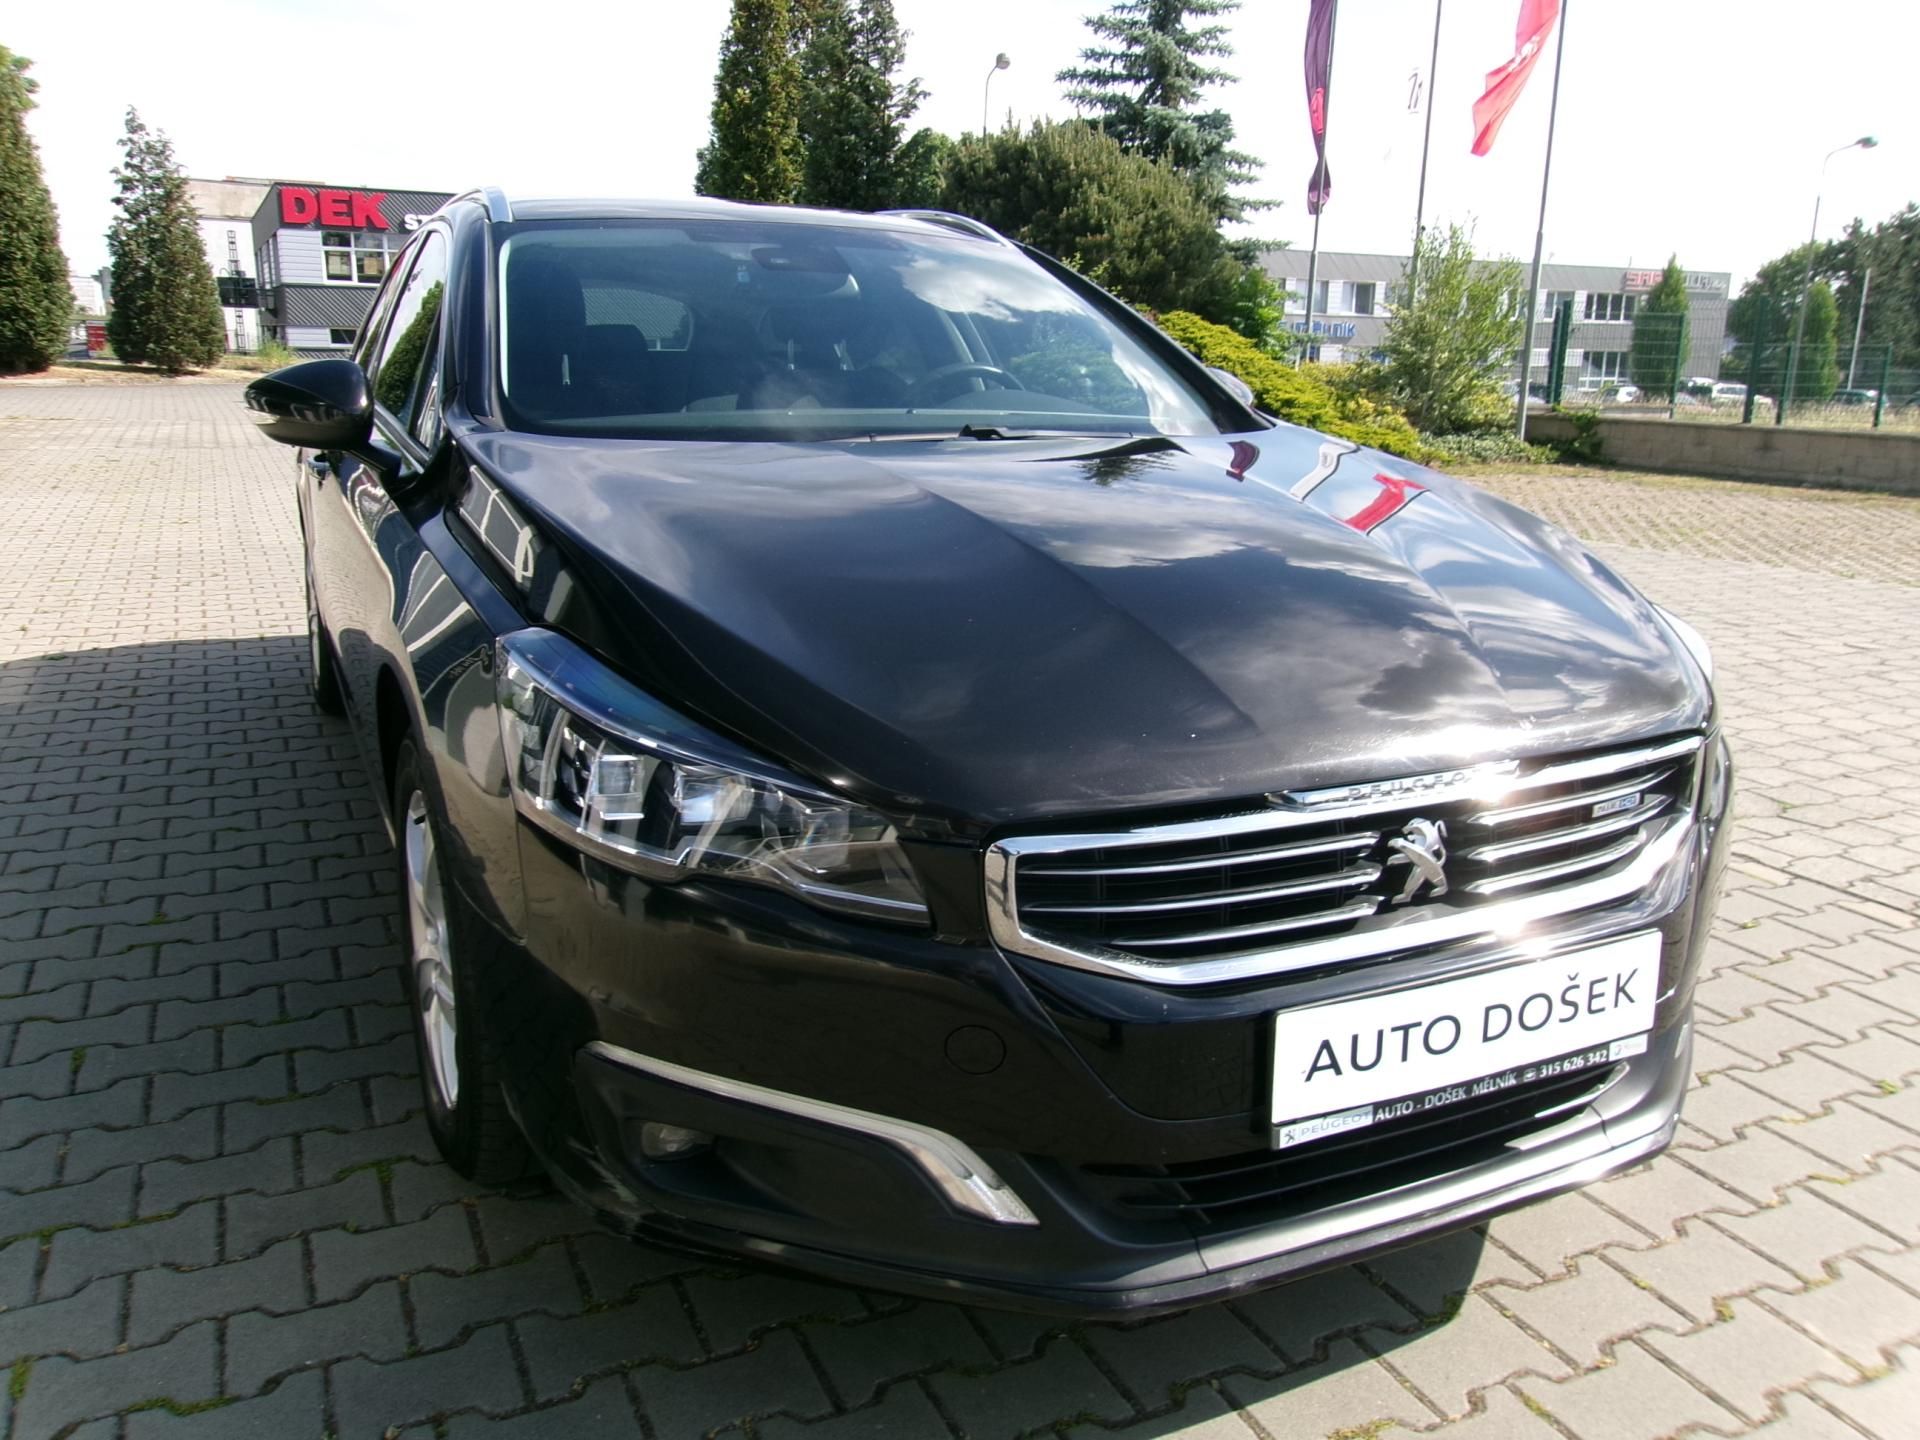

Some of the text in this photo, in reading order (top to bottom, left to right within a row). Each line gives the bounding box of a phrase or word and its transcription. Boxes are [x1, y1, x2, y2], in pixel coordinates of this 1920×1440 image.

[281, 186, 389, 229] DEK
[1348, 767, 1482, 801] PEUGEO
[1304, 967, 1640, 1083] AUTO DOŠEK
[1301, 1110, 1372, 1137] PEUGEOT
[1375, 1100, 1414, 1122] AUTO
[1424, 1086, 1467, 1109] DOŠEK
[1471, 1070, 1518, 1097] MĚLNÍK
[1539, 1061, 1561, 1079] 315
[1563, 1056, 1585, 1072] 626
[1586, 1050, 1608, 1067] 342
